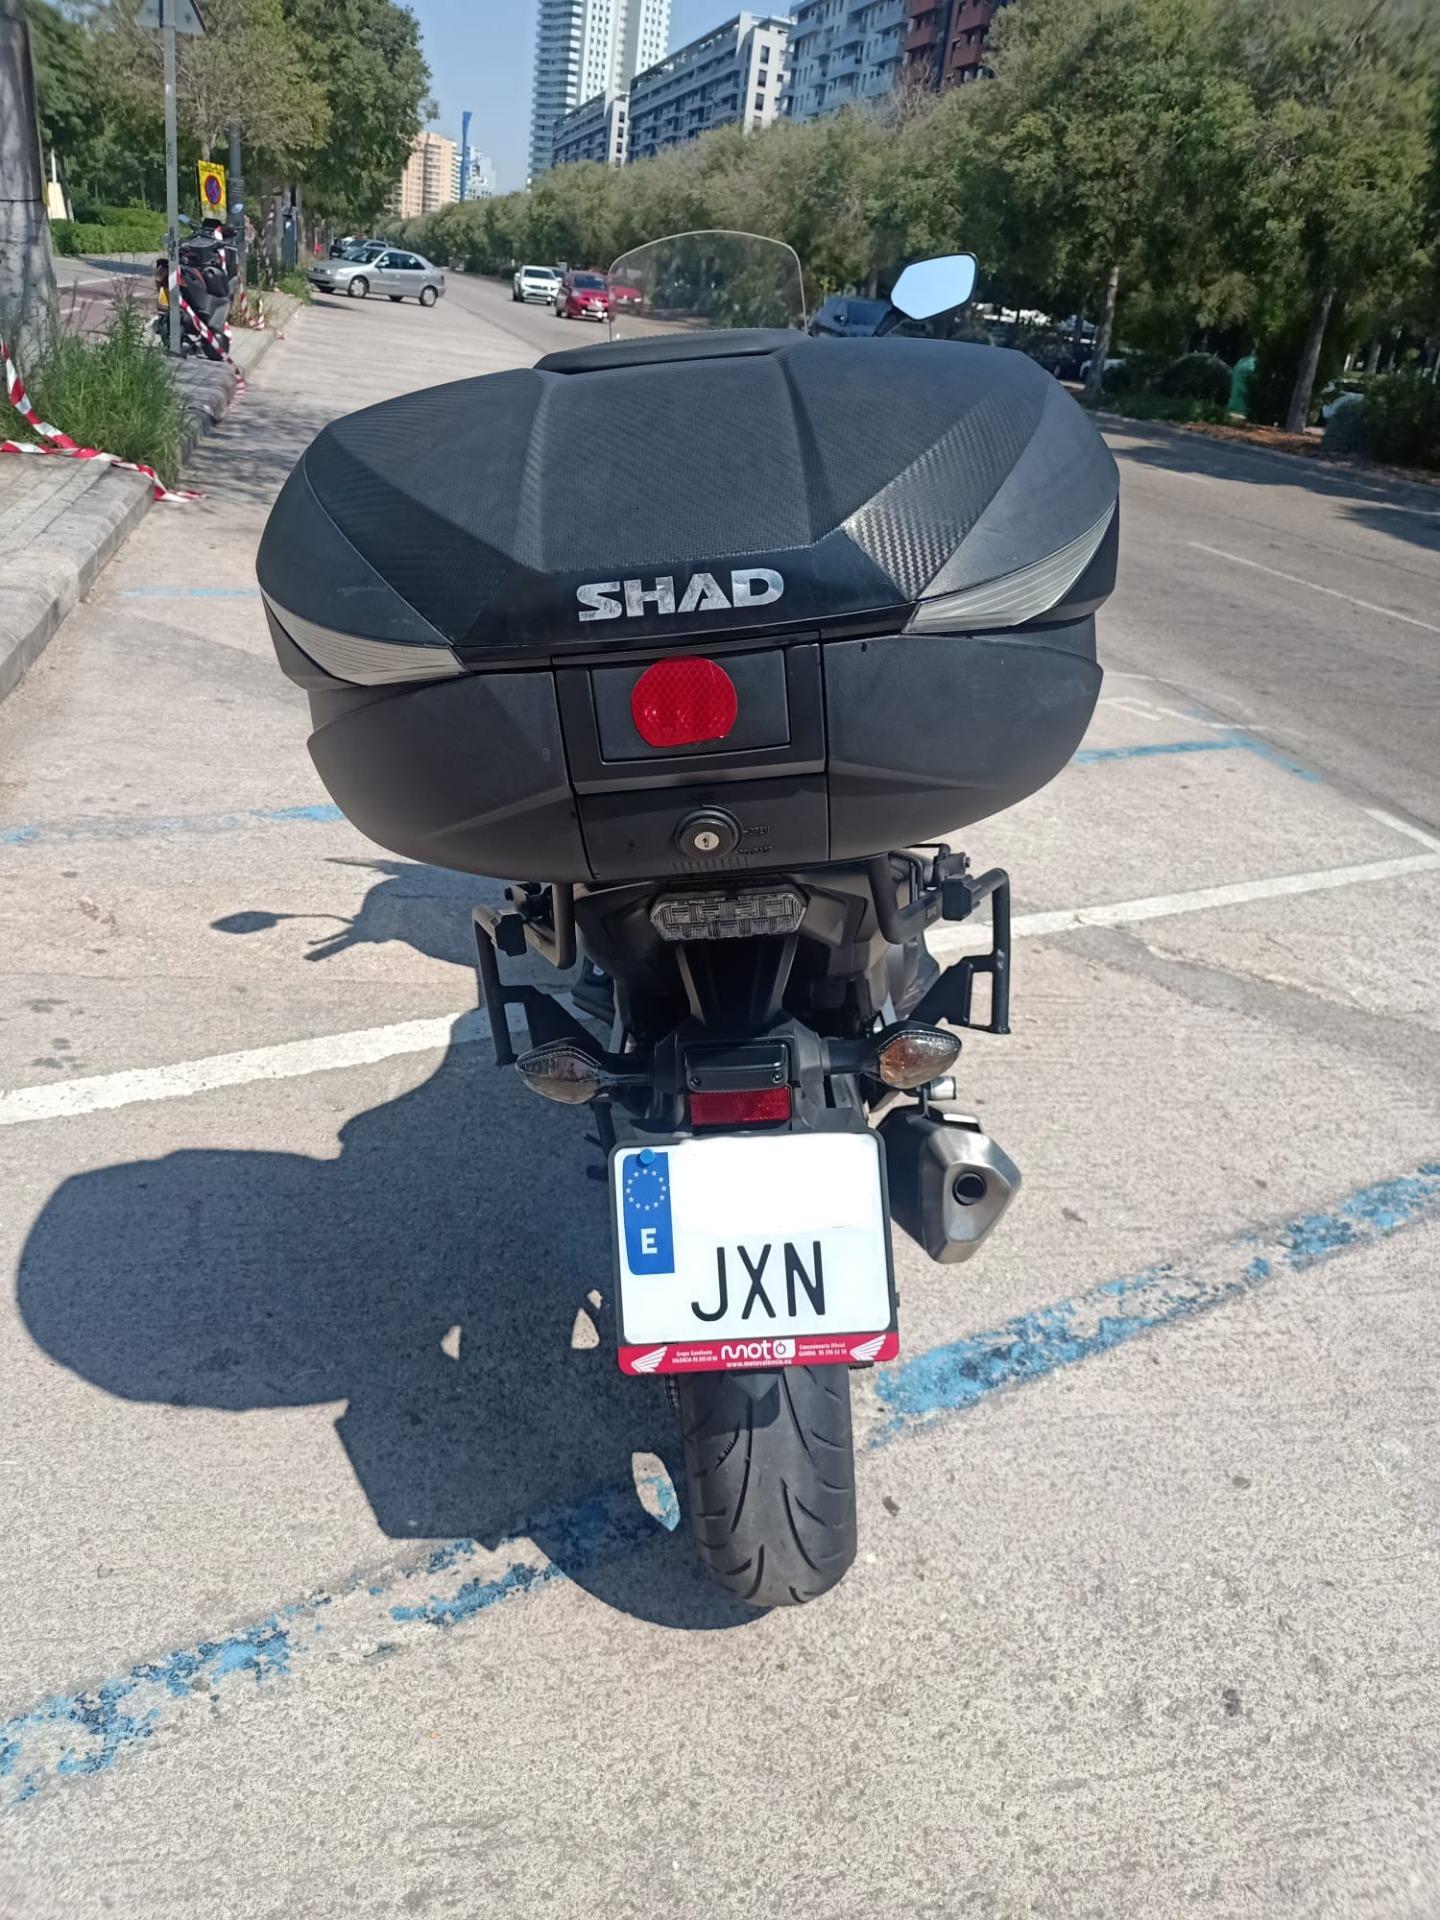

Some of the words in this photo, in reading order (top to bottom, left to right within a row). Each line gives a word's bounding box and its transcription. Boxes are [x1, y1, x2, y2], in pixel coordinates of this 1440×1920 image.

[576, 568, 785, 622] SHAD
[641, 1228, 658, 1255] E
[691, 1240, 826, 1322] JXN
